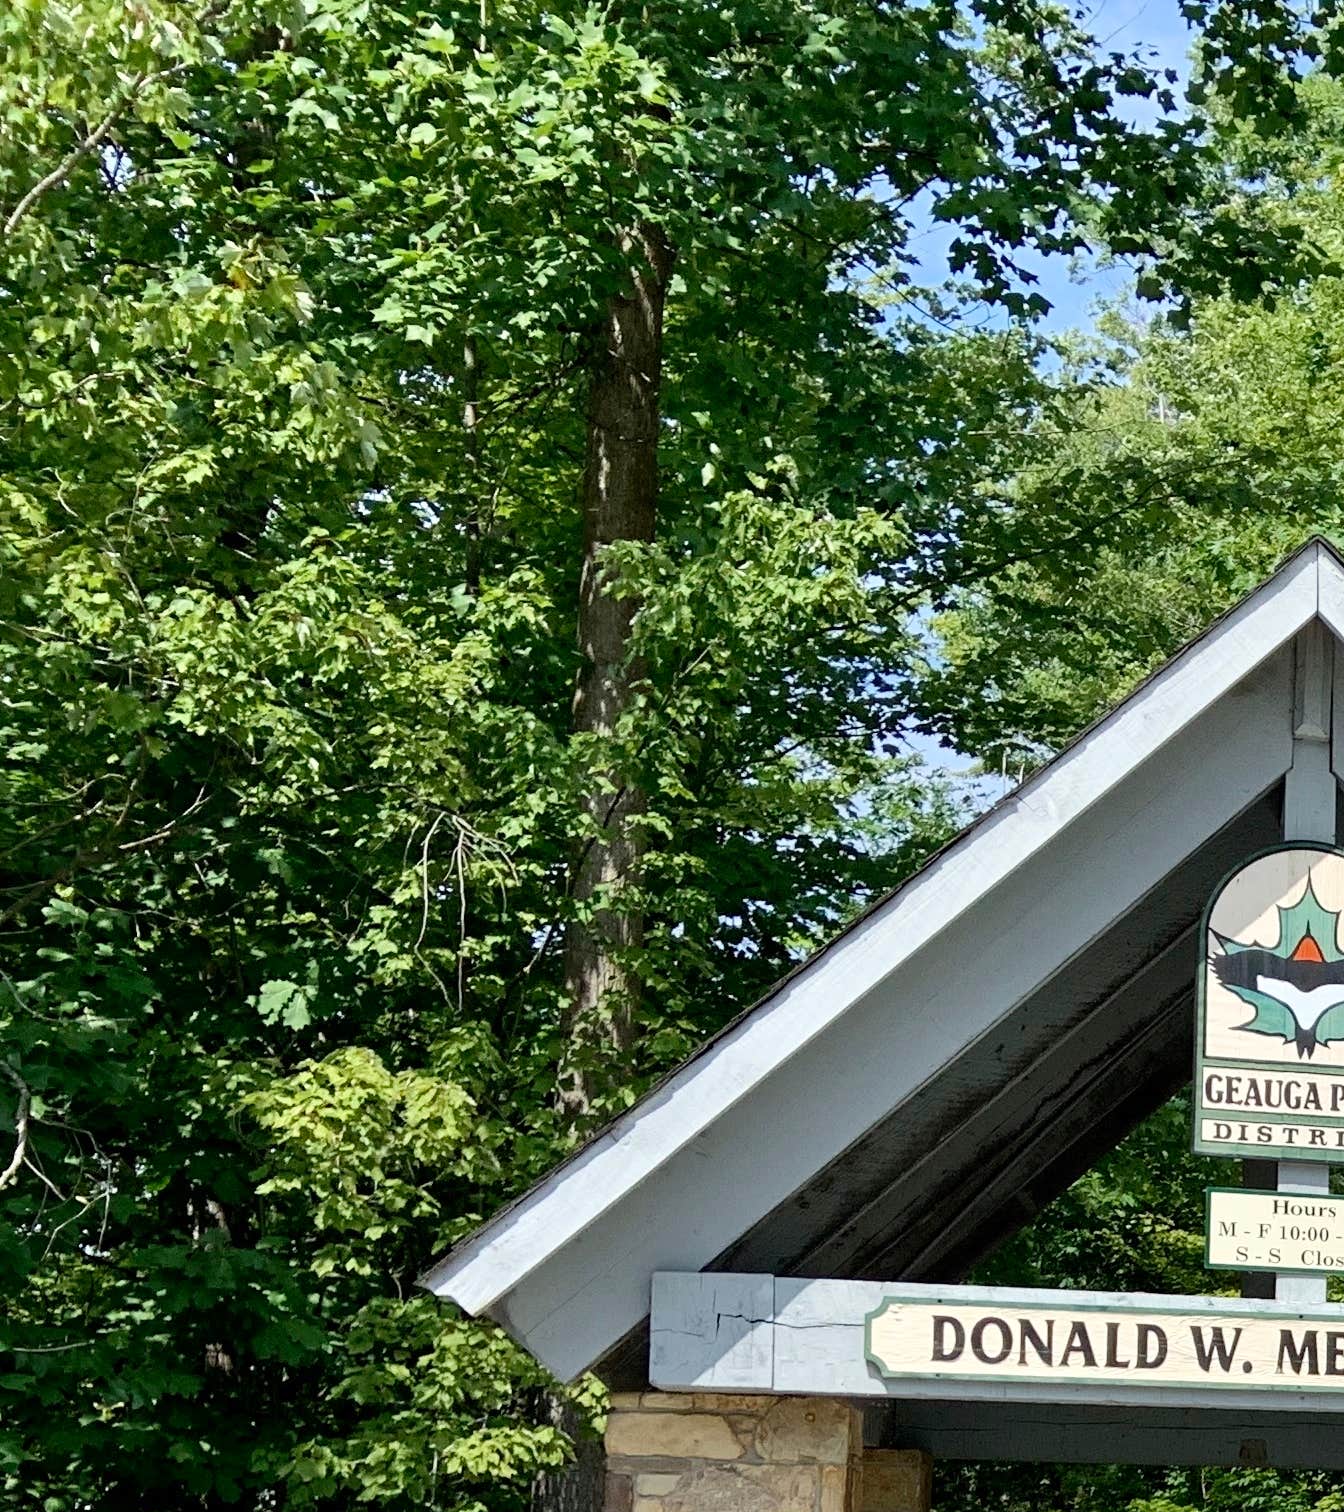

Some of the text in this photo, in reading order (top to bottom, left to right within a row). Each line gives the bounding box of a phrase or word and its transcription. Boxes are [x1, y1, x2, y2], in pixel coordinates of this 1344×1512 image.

[1205, 1074, 1323, 1110] GEAUGA
[1273, 1199, 1337, 1218] Hours
[1218, 1221, 1237, 1237] M
[1259, 1223, 1272, 1239] F
[1279, 1225, 1329, 1242] 10:00
[1236, 1247, 1249, 1262] S
[1268, 1248, 1282, 1264] S
[931, 1314, 1168, 1370] DONALD
[1190, 1325, 1253, 1374] W.
